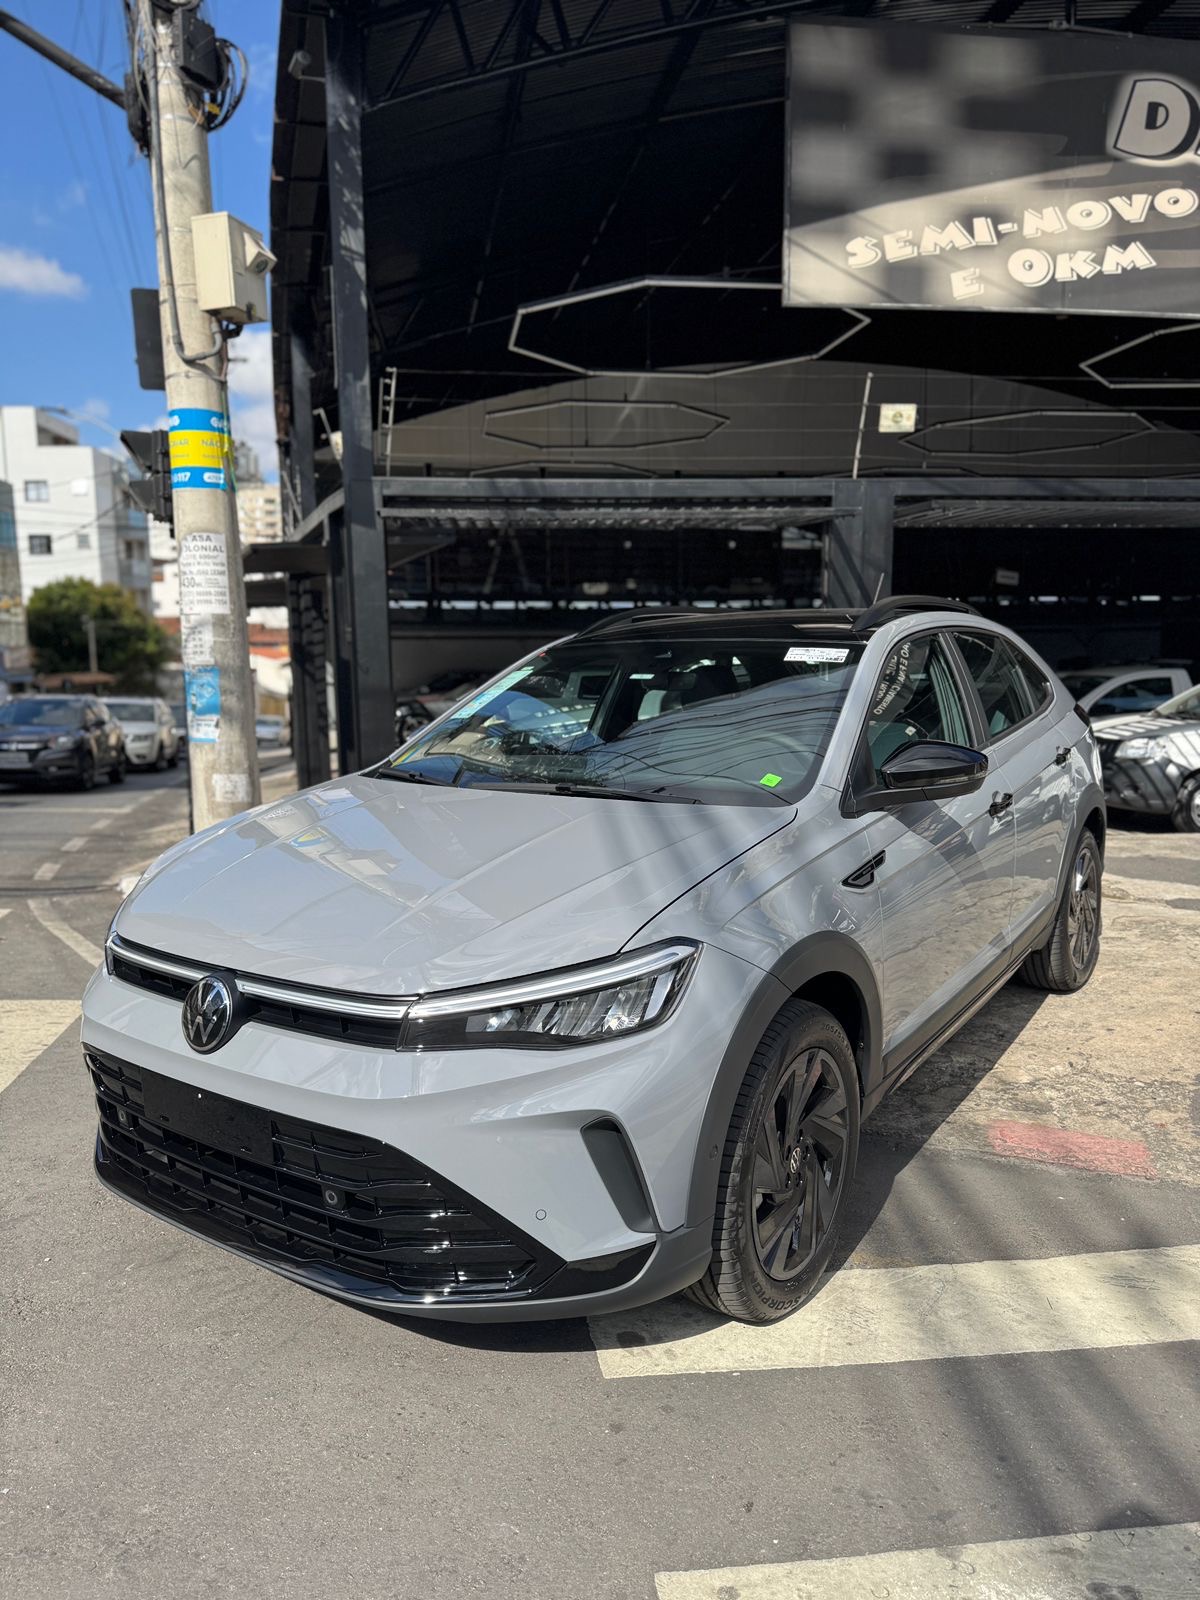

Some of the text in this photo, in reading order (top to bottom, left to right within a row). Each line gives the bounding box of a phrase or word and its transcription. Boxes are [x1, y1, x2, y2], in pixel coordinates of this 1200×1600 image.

[1113, 77, 1200, 160] D
[845, 187, 1199, 269] SEMI-NOVO
[950, 267, 984, 300] E
